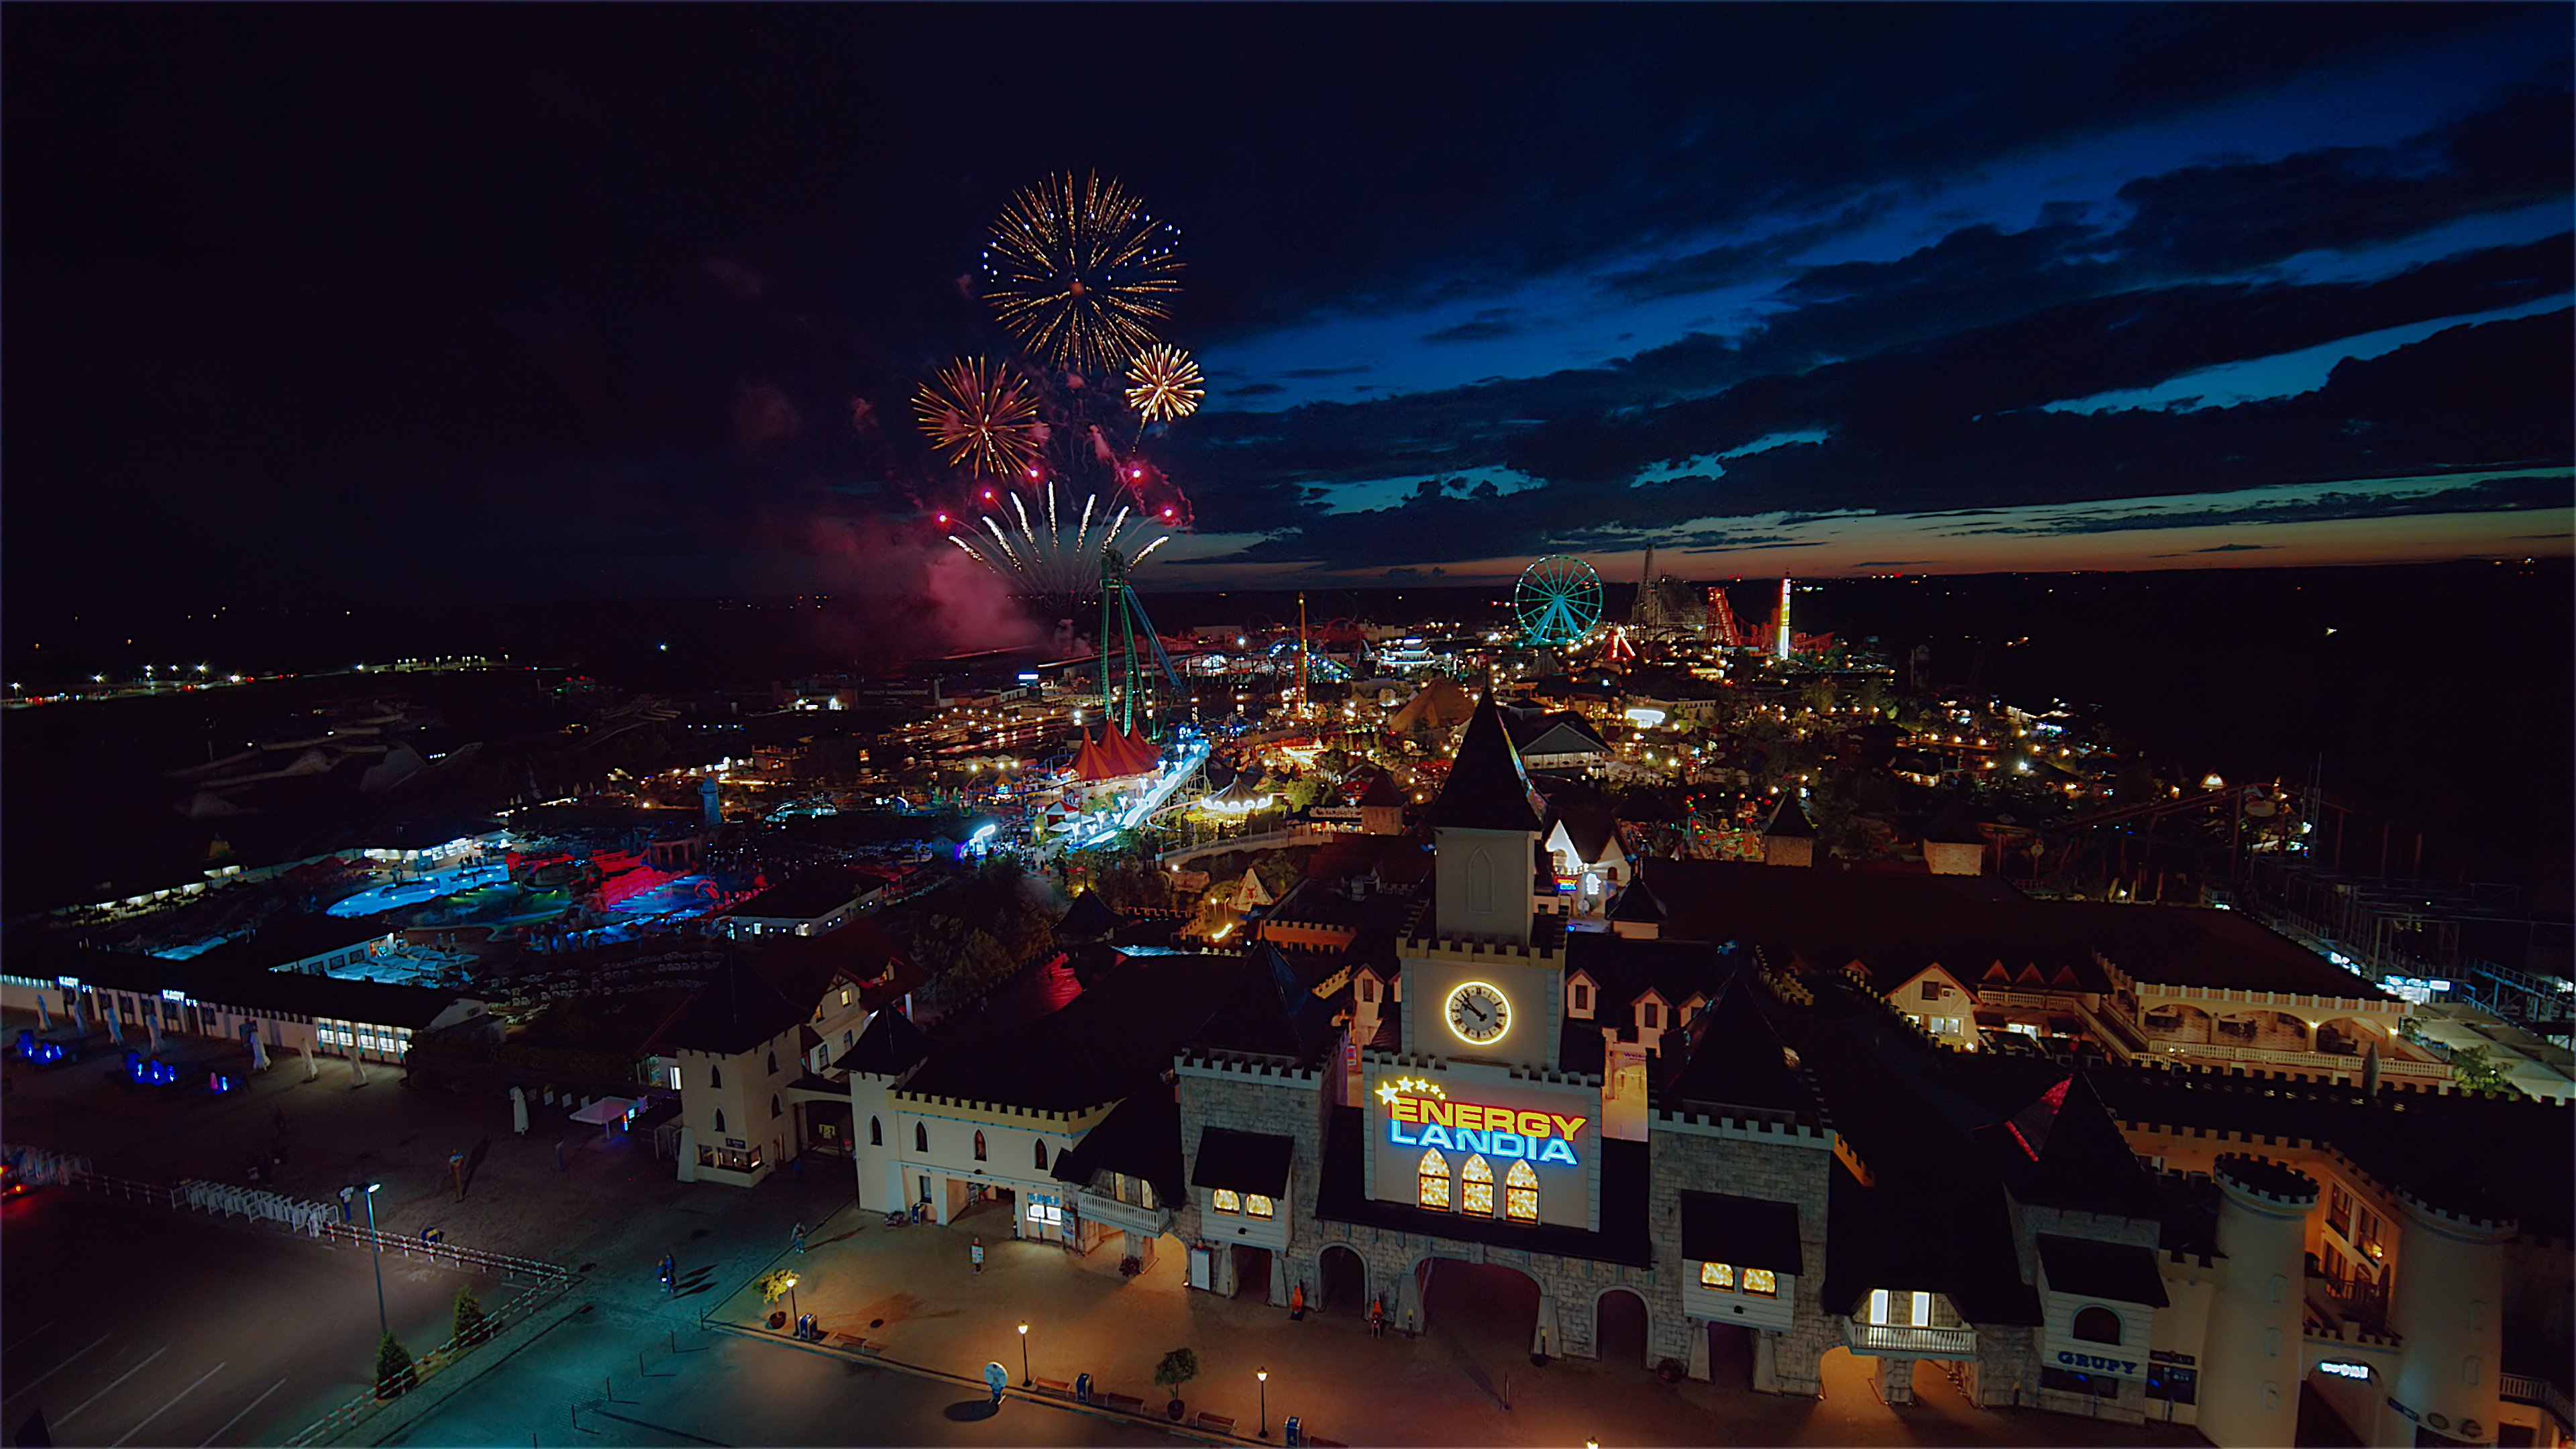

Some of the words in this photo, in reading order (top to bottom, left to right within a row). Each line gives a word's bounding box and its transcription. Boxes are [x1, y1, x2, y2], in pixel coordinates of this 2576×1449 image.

[1391, 1096, 1587, 1141] ENERGY
[1391, 1119, 1578, 1166] LANDIA
[2058, 1351, 2137, 1375] GRUPY
